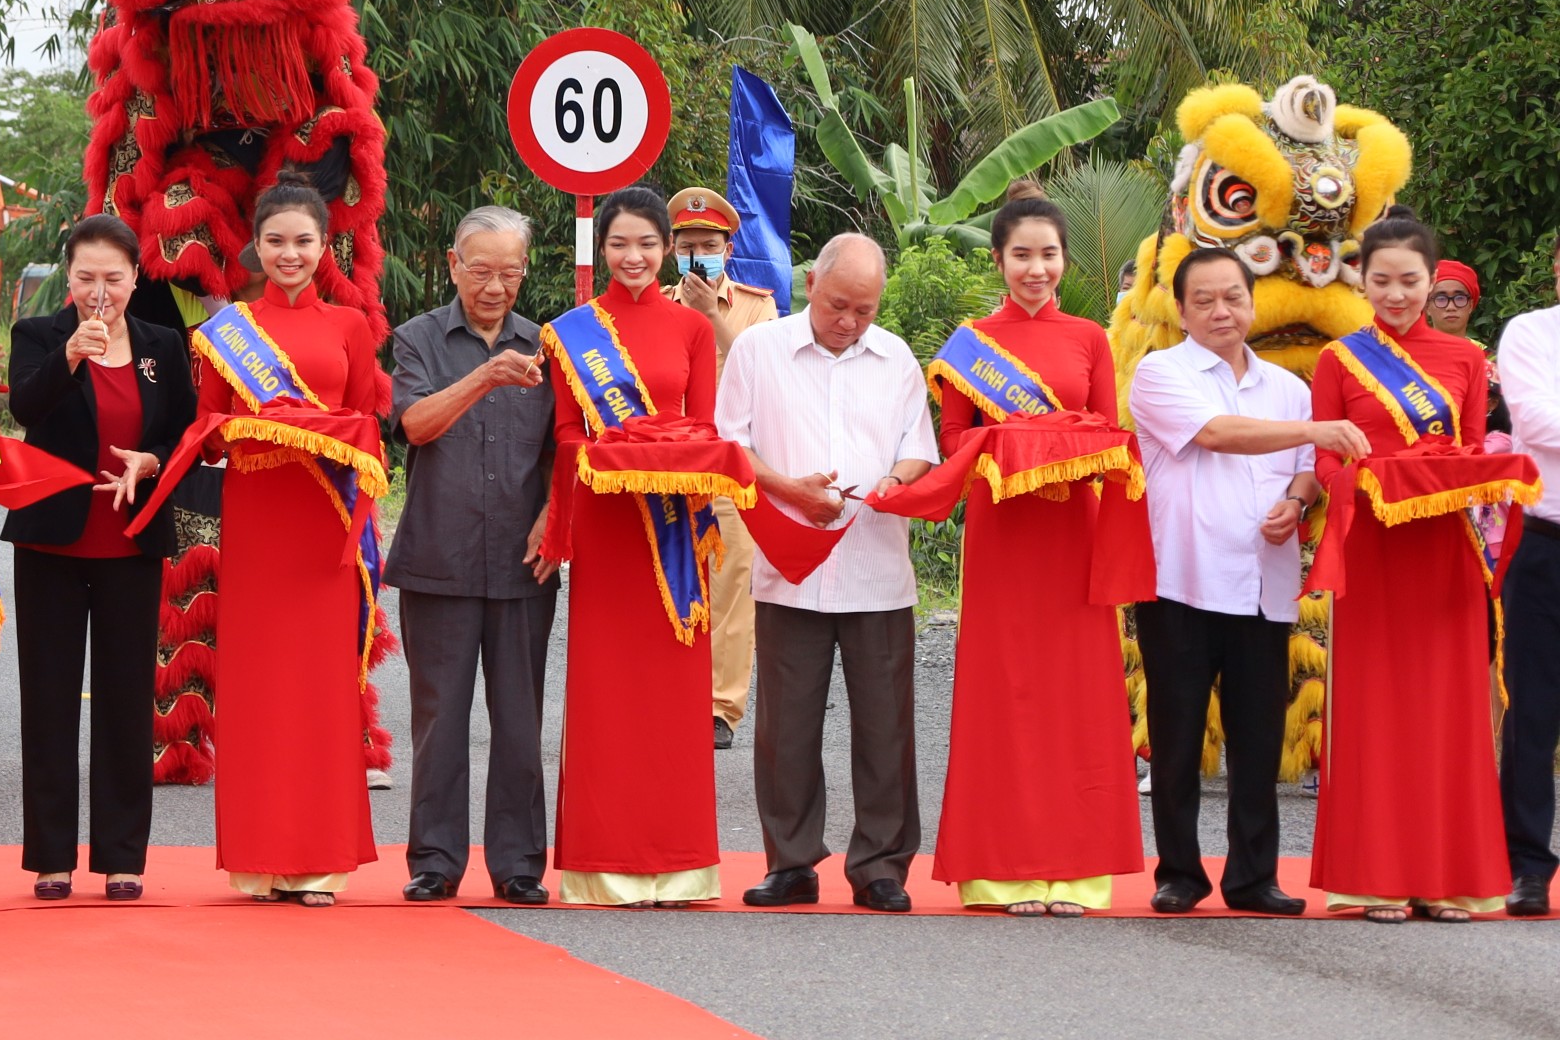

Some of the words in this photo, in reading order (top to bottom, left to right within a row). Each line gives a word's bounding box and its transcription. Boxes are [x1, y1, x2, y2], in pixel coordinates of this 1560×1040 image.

[554, 77, 623, 144] 60
[217, 322, 249, 356] KÍNH
[242, 351, 279, 392] CHÀO
[582, 348, 614, 387] KÍNH
[603, 387, 635, 423] CHÀ
[970, 357, 1008, 392] KÍNH
[1400, 381, 1437, 421] KÍNH
